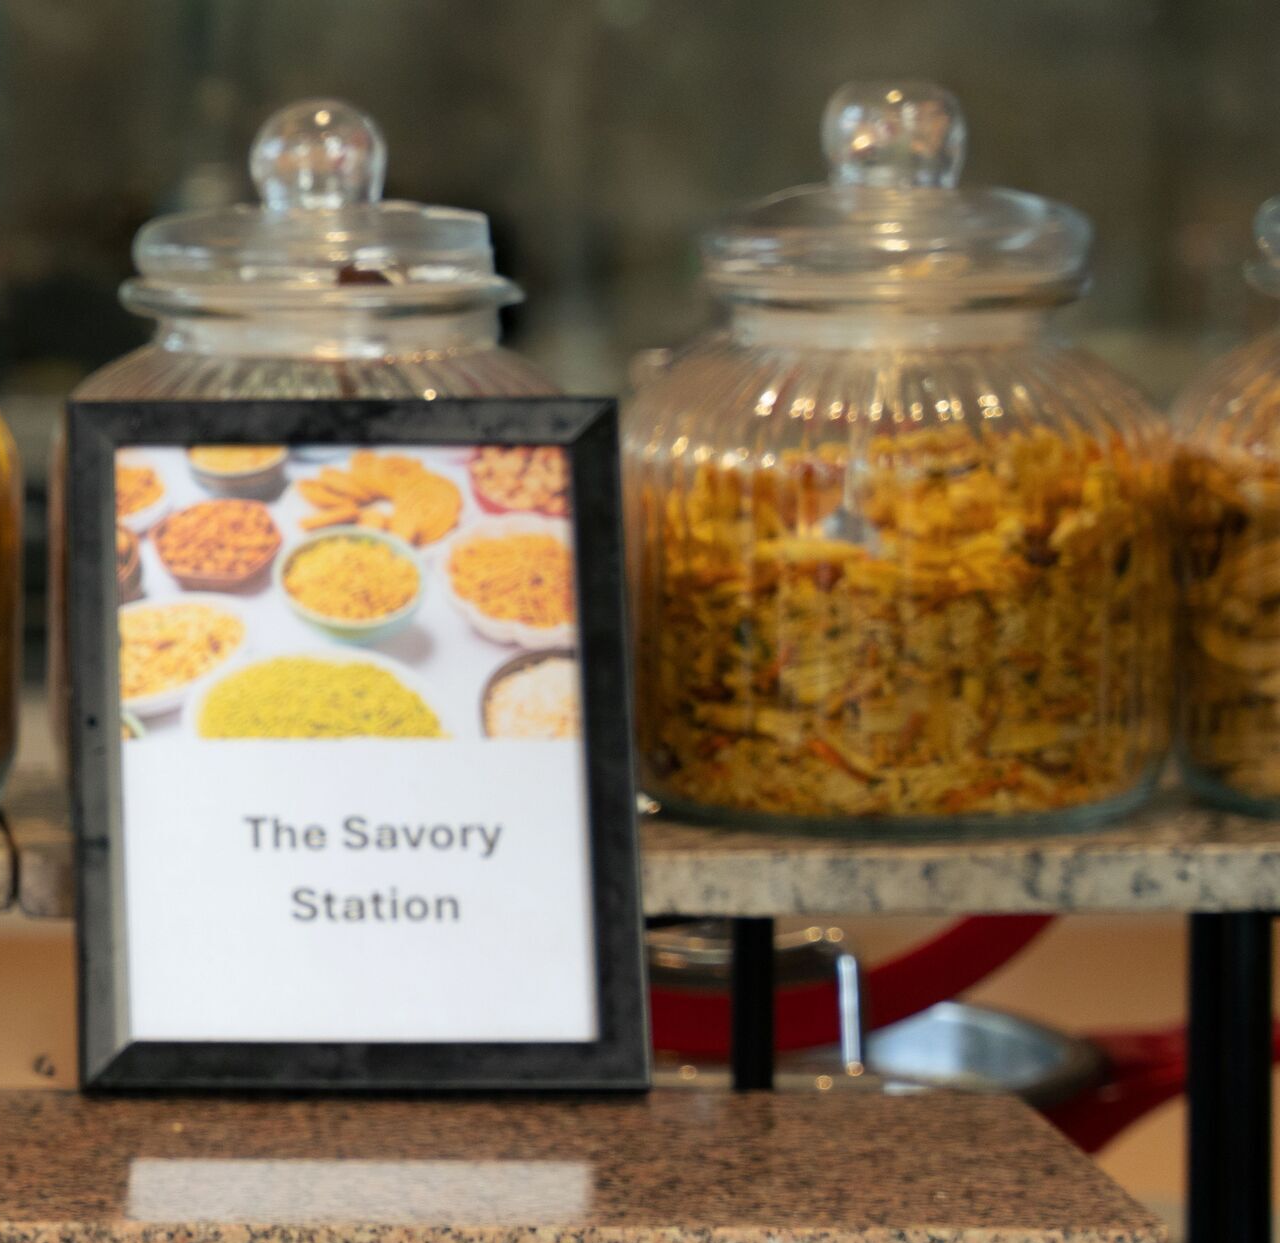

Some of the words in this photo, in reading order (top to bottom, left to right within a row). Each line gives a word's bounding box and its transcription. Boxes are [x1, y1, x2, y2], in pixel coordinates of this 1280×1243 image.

[245, 815, 328, 850] The
[342, 815, 503, 860] Savory
[291, 886, 461, 923] Station
